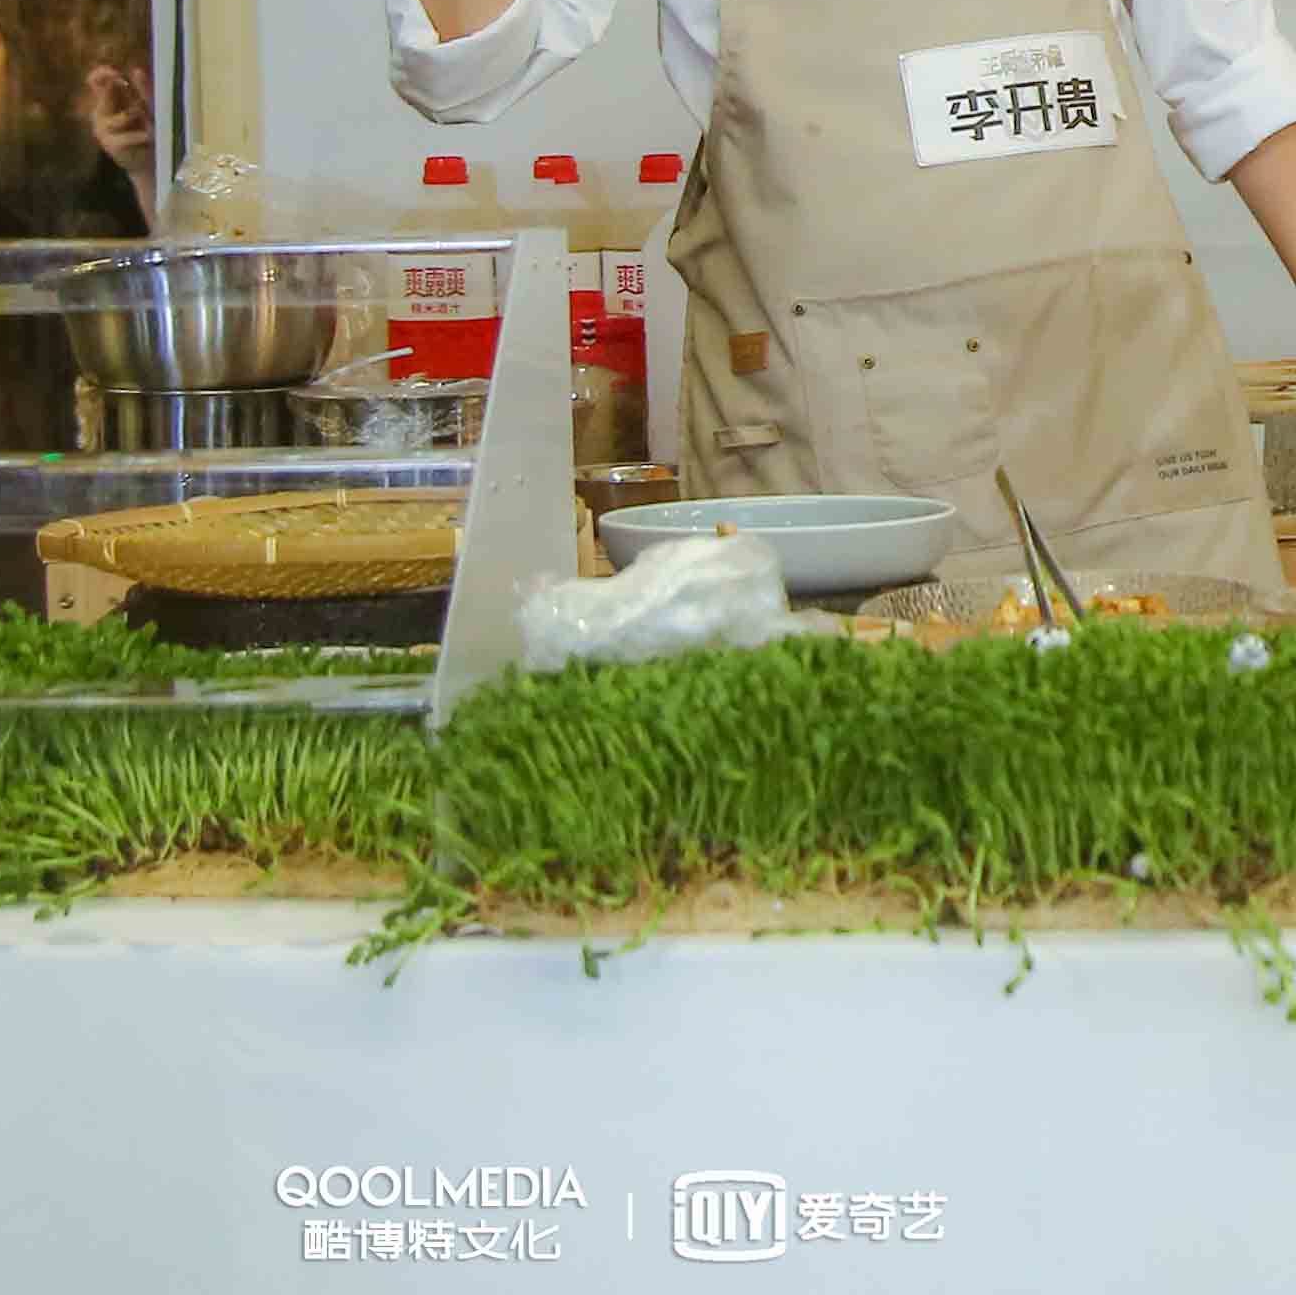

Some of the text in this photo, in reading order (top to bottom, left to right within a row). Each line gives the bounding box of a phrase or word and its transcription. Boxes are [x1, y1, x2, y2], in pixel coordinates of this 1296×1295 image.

[945, 77, 1099, 141] 李开贵
[403, 267, 466, 298] 爽露爽
